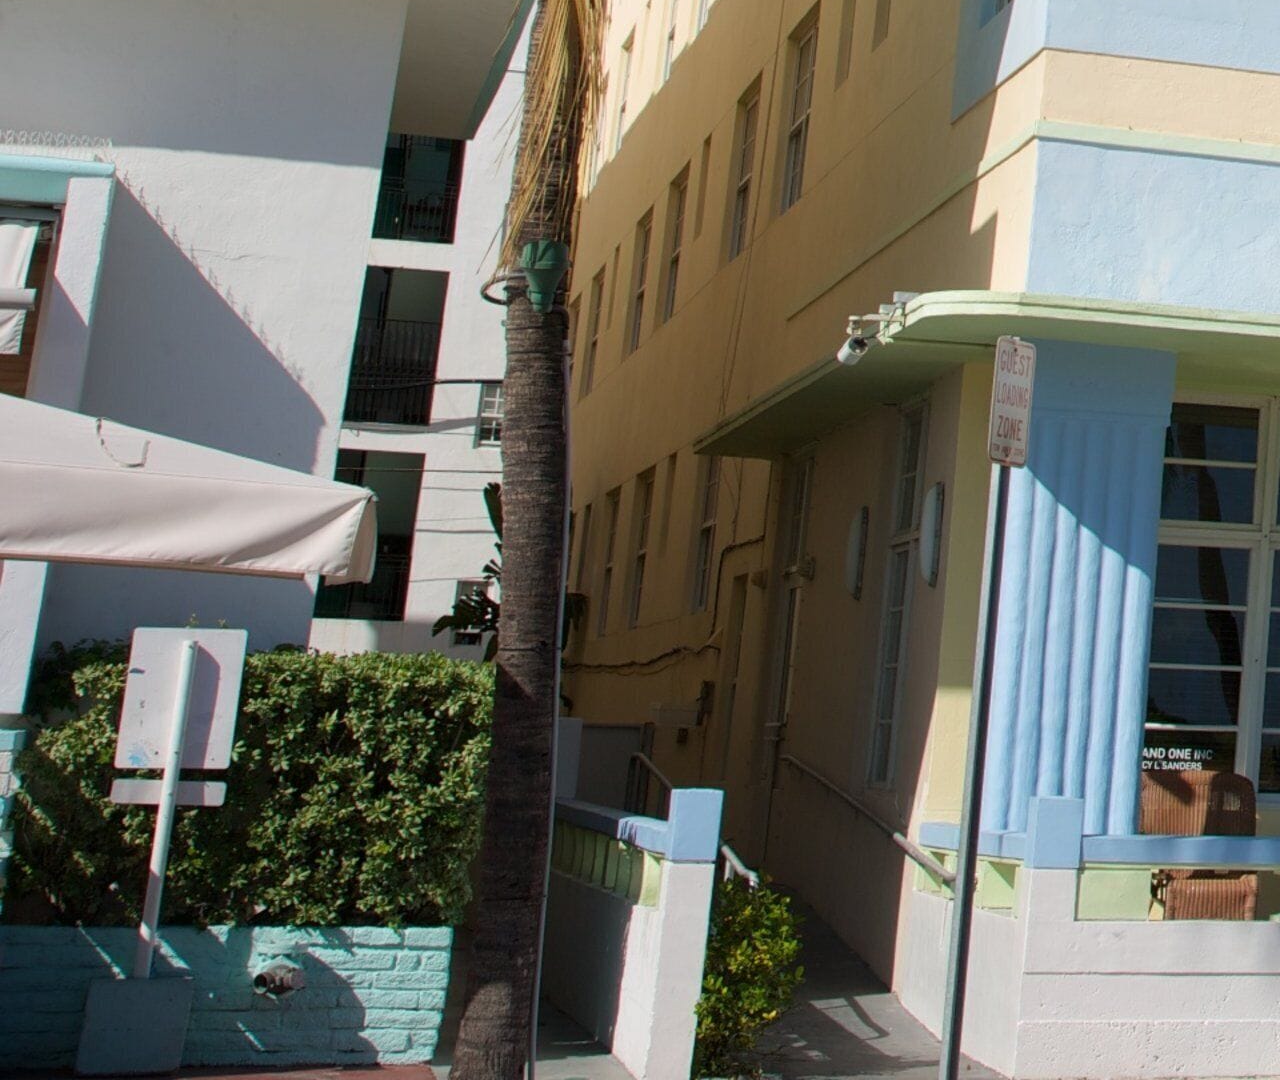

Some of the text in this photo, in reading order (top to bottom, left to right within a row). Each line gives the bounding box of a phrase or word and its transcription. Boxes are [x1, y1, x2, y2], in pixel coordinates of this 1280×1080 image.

[1000, 349, 1032, 377] GUEST
[997, 382, 1029, 410] LOADING
[996, 415, 1023, 442] ZONE
[1141, 761, 1153, 769] CY
[1161, 761, 1202, 771] SANDERS
[1142, 747, 1166, 759] AND
[1168, 748, 1192, 760] ONE
